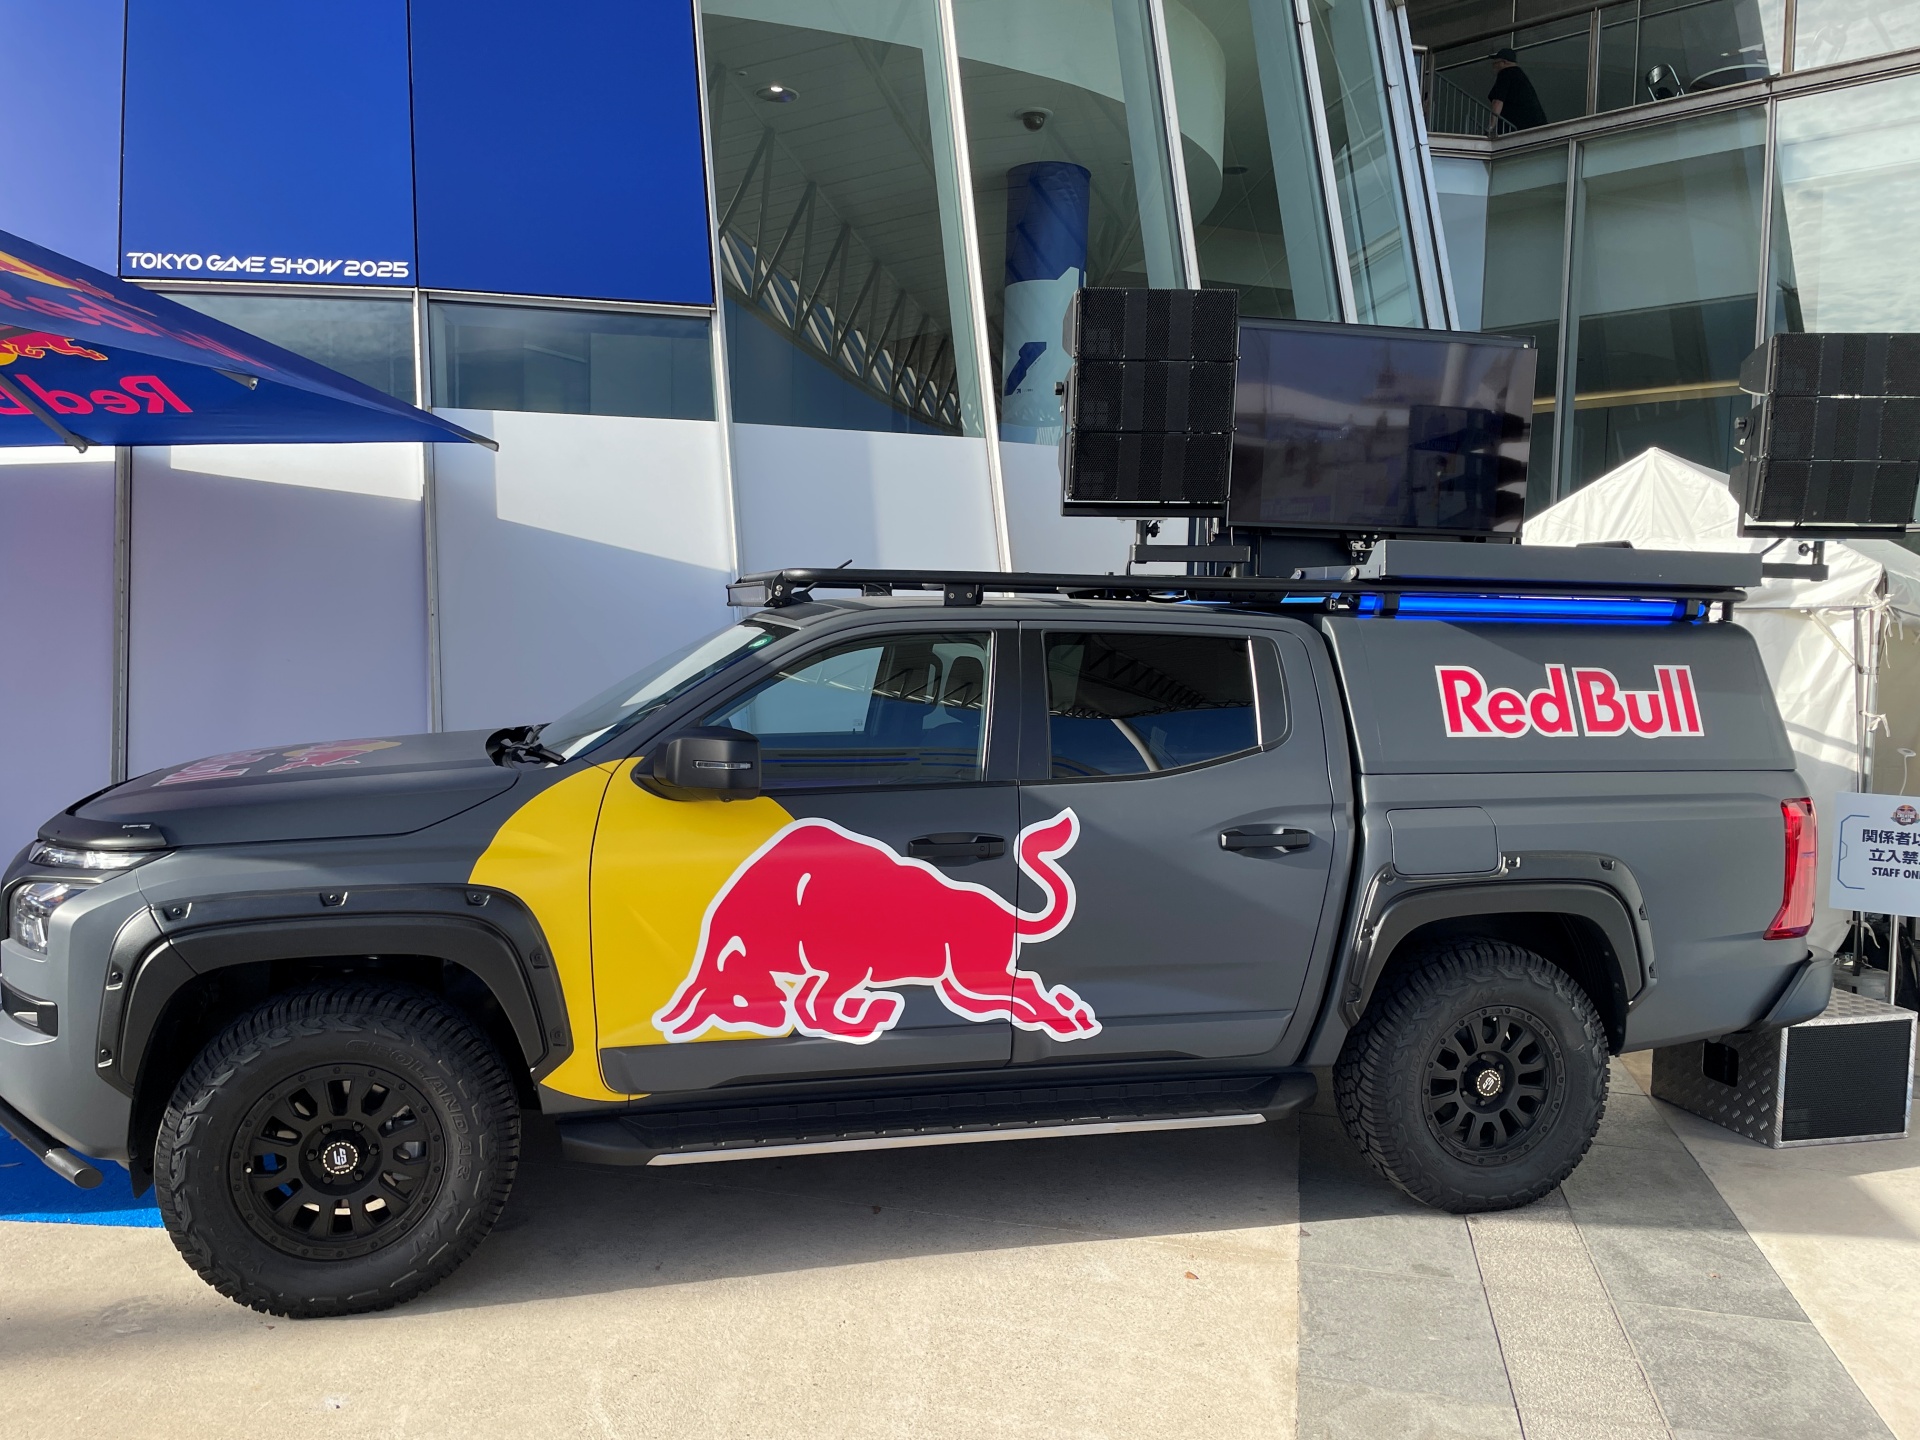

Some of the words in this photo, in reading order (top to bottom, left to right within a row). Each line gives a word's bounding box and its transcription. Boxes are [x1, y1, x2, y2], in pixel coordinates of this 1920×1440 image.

[127, 252, 203, 271] TOKYO
[206, 254, 267, 273] GAME
[270, 257, 343, 276] SHOW
[344, 260, 409, 278] 2025
[1436, 664, 1578, 738] Red
[1572, 665, 1704, 738] Bull
[1869, 848, 1920, 865] 立入禁
[1871, 867, 1901, 878] STAFF
[1903, 869, 1920, 880] ON
